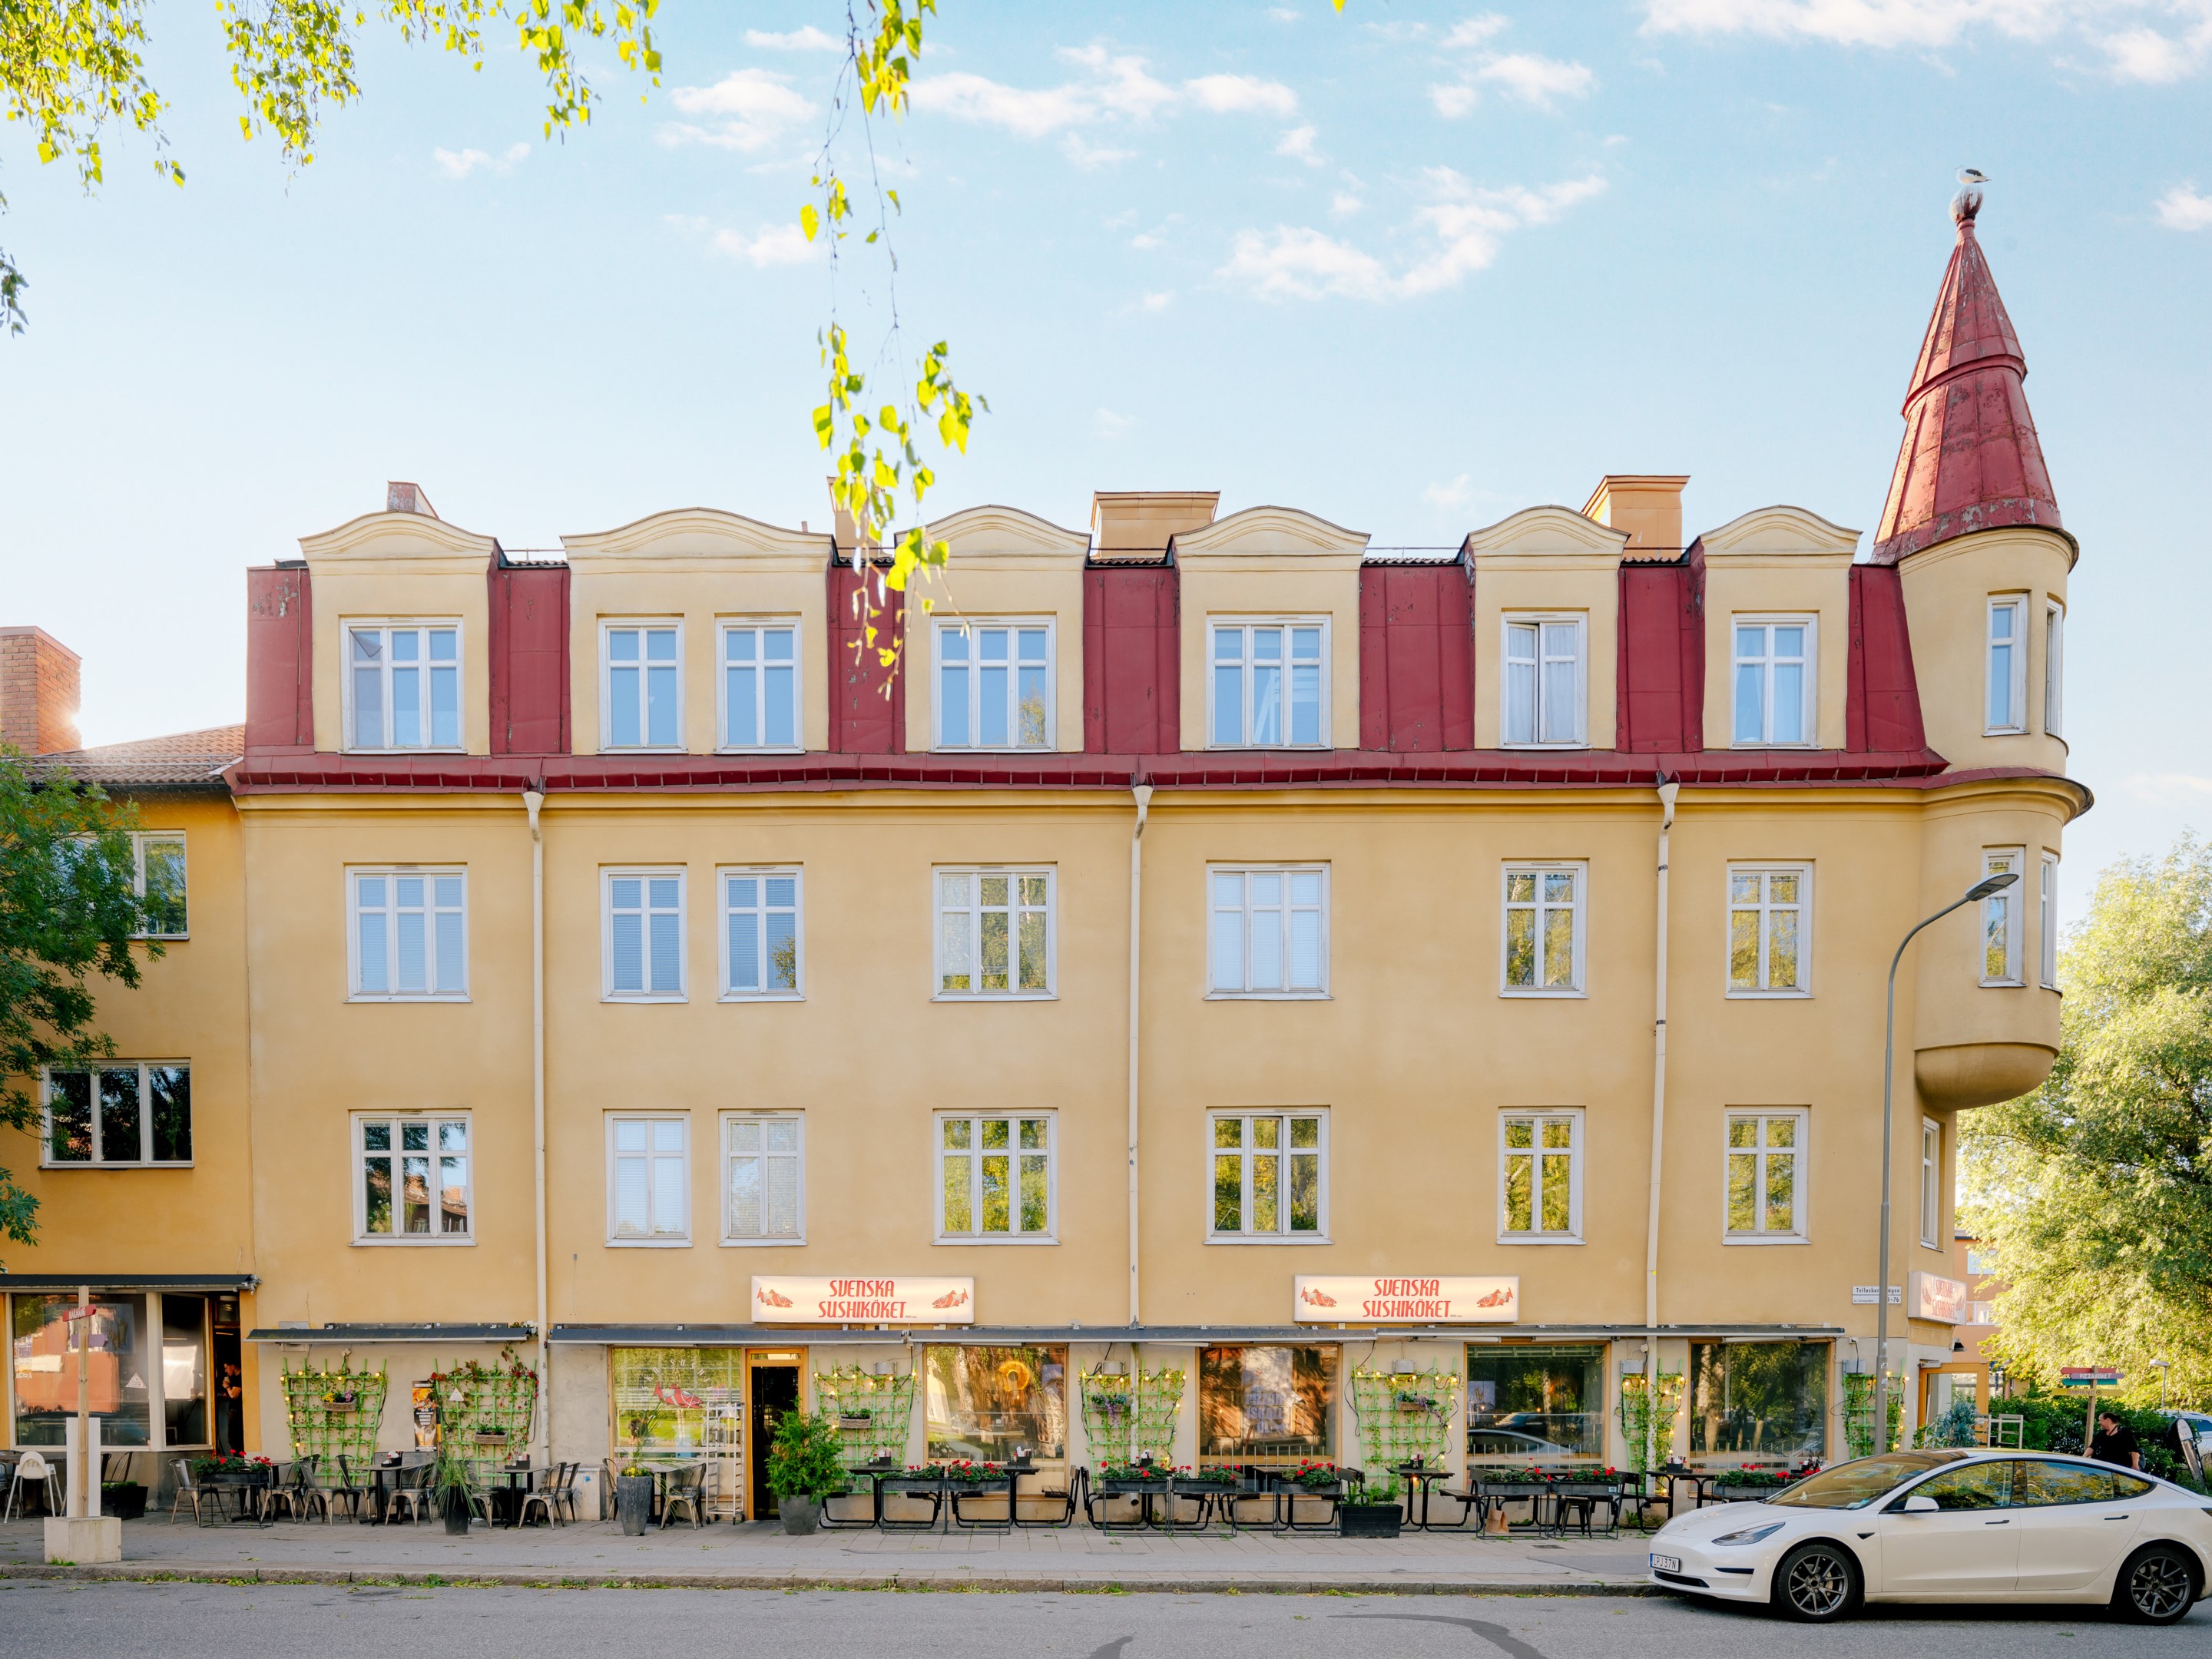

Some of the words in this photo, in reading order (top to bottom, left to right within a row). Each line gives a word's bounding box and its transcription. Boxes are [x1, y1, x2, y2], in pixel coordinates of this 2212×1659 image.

[830, 1280, 894, 1297] SVENSKA
[1374, 1279, 1439, 1296] SVENSKA
[818, 1300, 906, 1318] SUSHIKÖKET
[1363, 1300, 1451, 1318] SUSHIKÖKET
